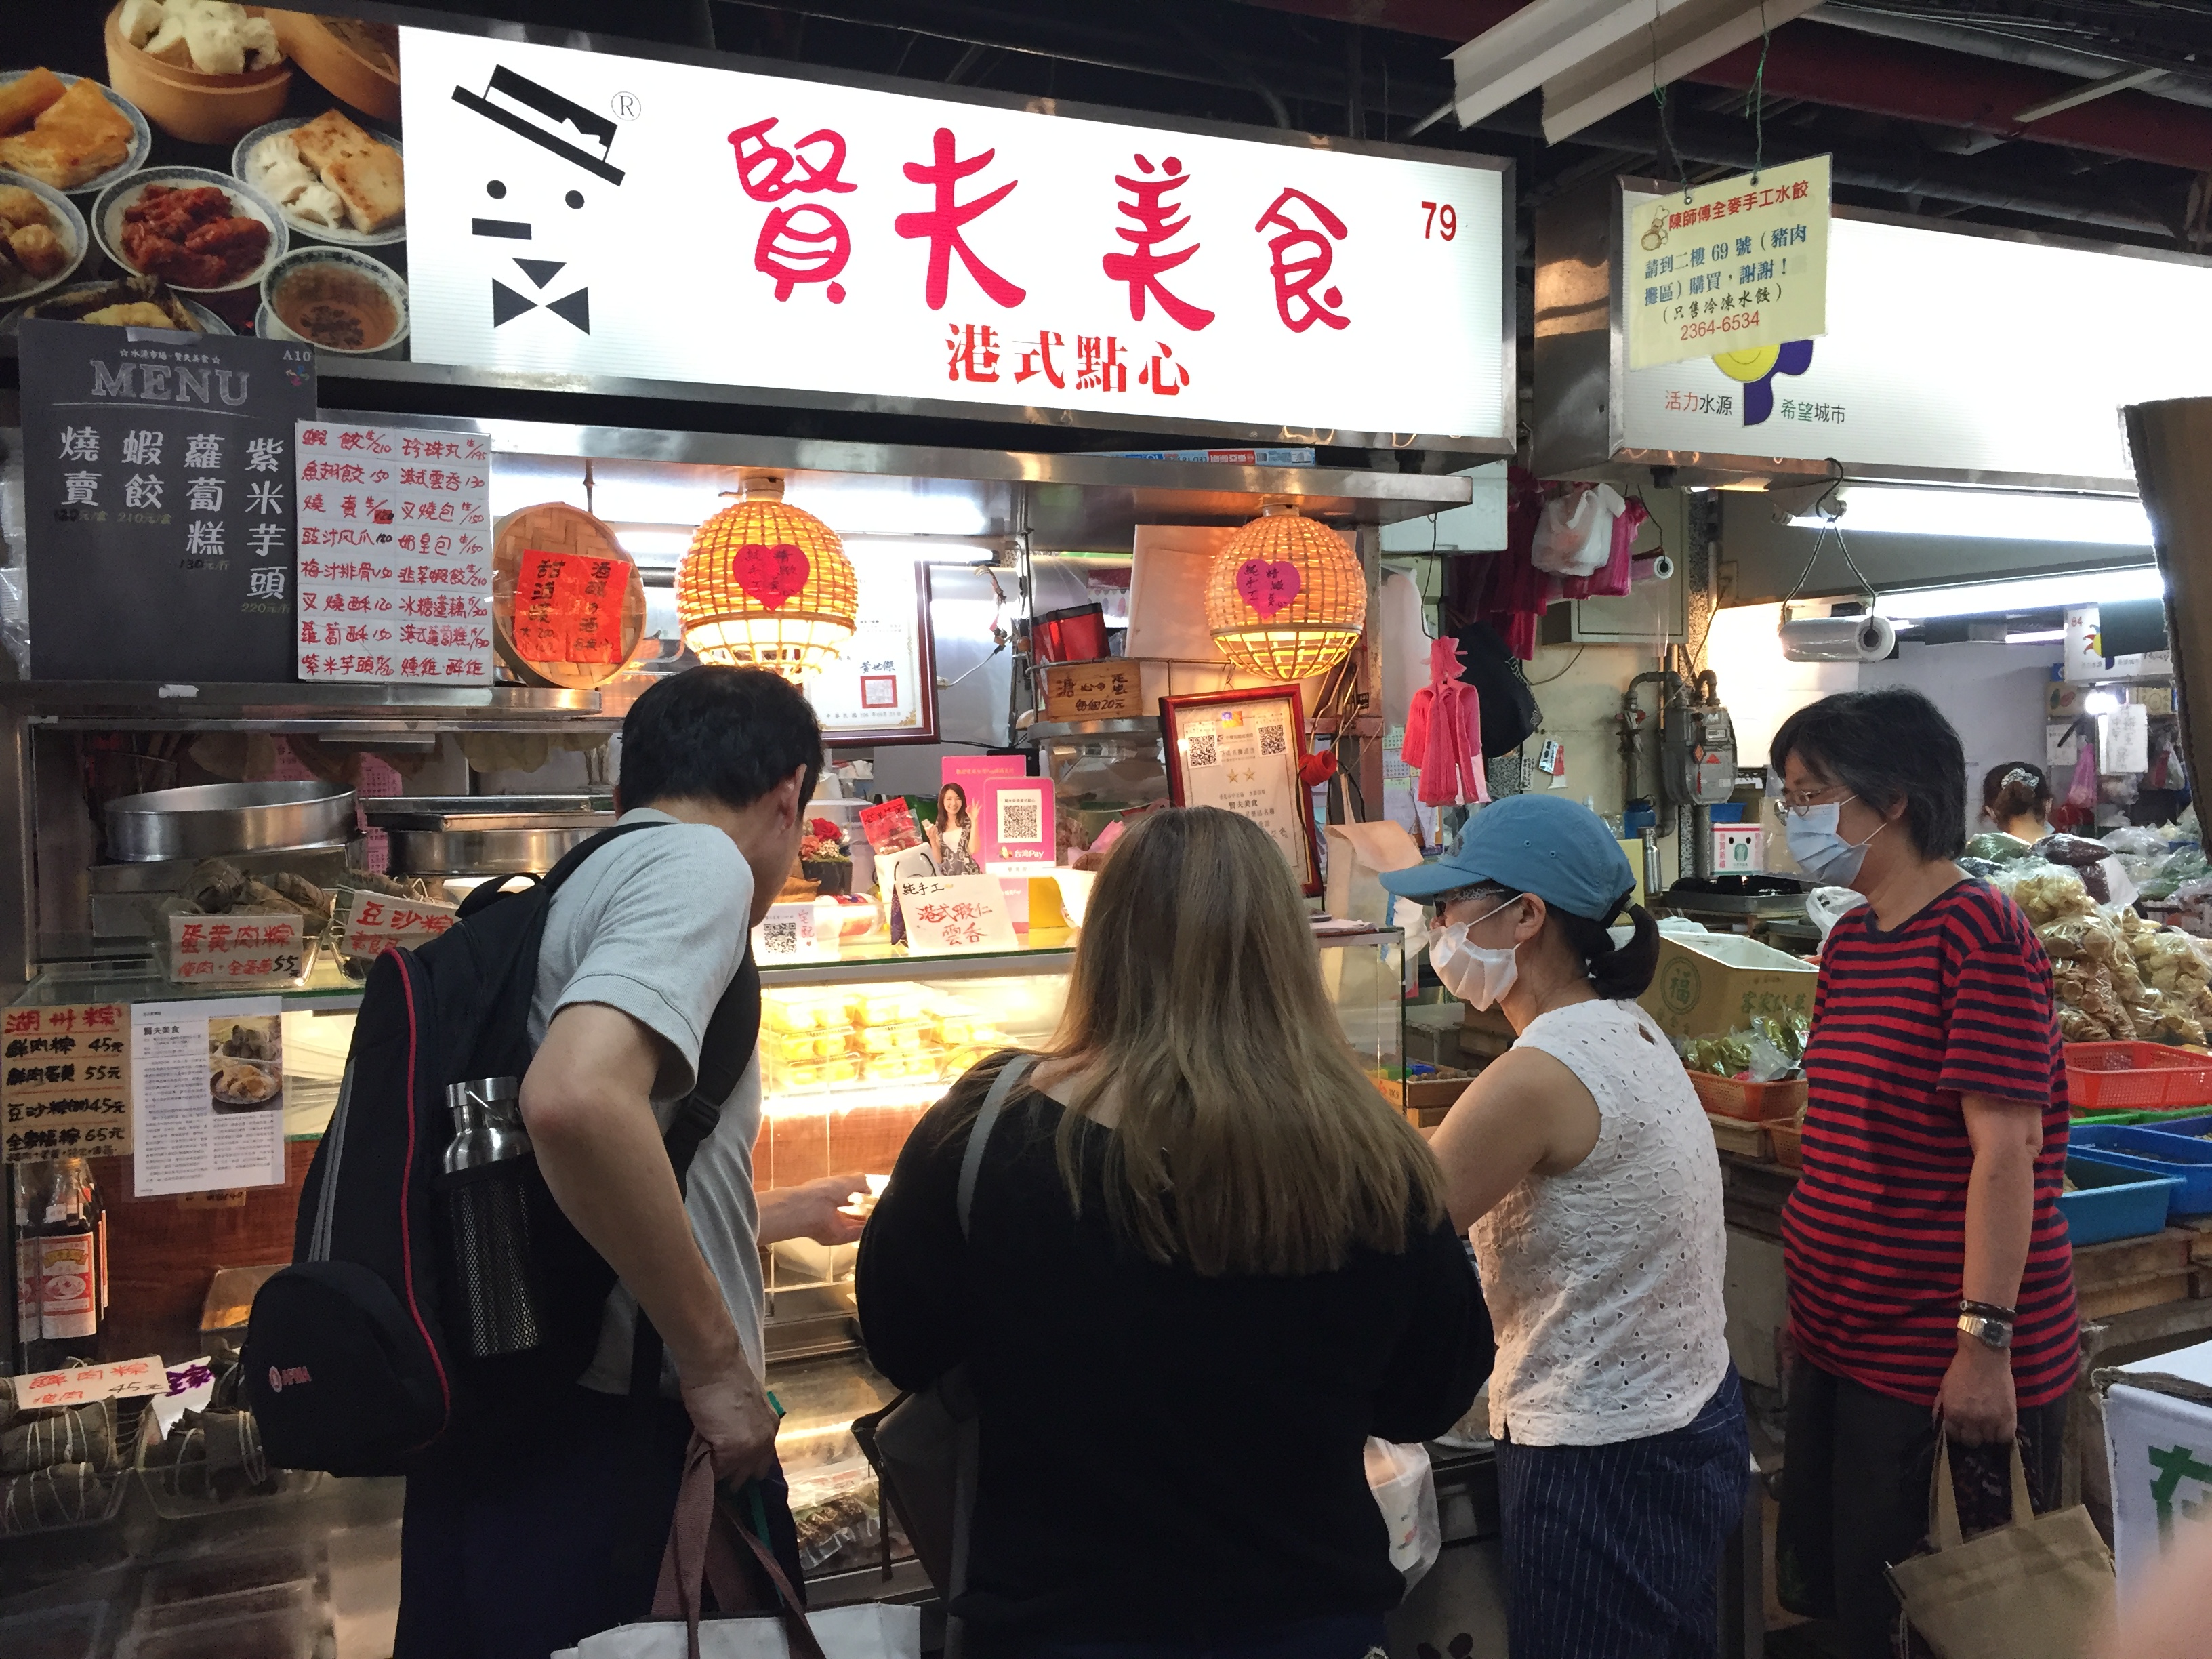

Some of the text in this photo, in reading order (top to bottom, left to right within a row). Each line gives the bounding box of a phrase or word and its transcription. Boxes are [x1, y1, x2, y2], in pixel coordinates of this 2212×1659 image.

[1668, 180, 1809, 231] 陳師傅全麥手工水餃
[727, 117, 1351, 333] 賢夫美食
[1421, 201, 1457, 241] 79
[1681, 310, 1760, 340] 2364-6534
[283, 350, 311, 362] A10
[946, 323, 1190, 396] 港式點心
[90, 360, 249, 405] MENU
[1664, 390, 1732, 415] 活力水源
[1781, 398, 1845, 424] 希望城市
[402, 438, 461, 459] 珍珠丸
[59, 426, 101, 506] 燒賣
[121, 430, 164, 509] 蝦餃
[370, 469, 389, 483] 150
[184, 434, 226, 555] 蘿蔔糕
[466, 476, 485, 488] 130
[245, 438, 288, 599] 紫米芋頭
[402, 501, 454, 522] 叉燒包
[2071, 617, 2083, 627] 84
[1229, 799, 1258, 810] 賢夫美食
[1015, 848, 1044, 859] 台灣Pay
[901, 882, 945, 896] 純手工
[916, 902, 993, 923] 港式蝦仁
[942, 922, 989, 946] 雲吞
[1669, 968, 1691, 1004] 福
[85, 1065, 121, 1080] 55元
